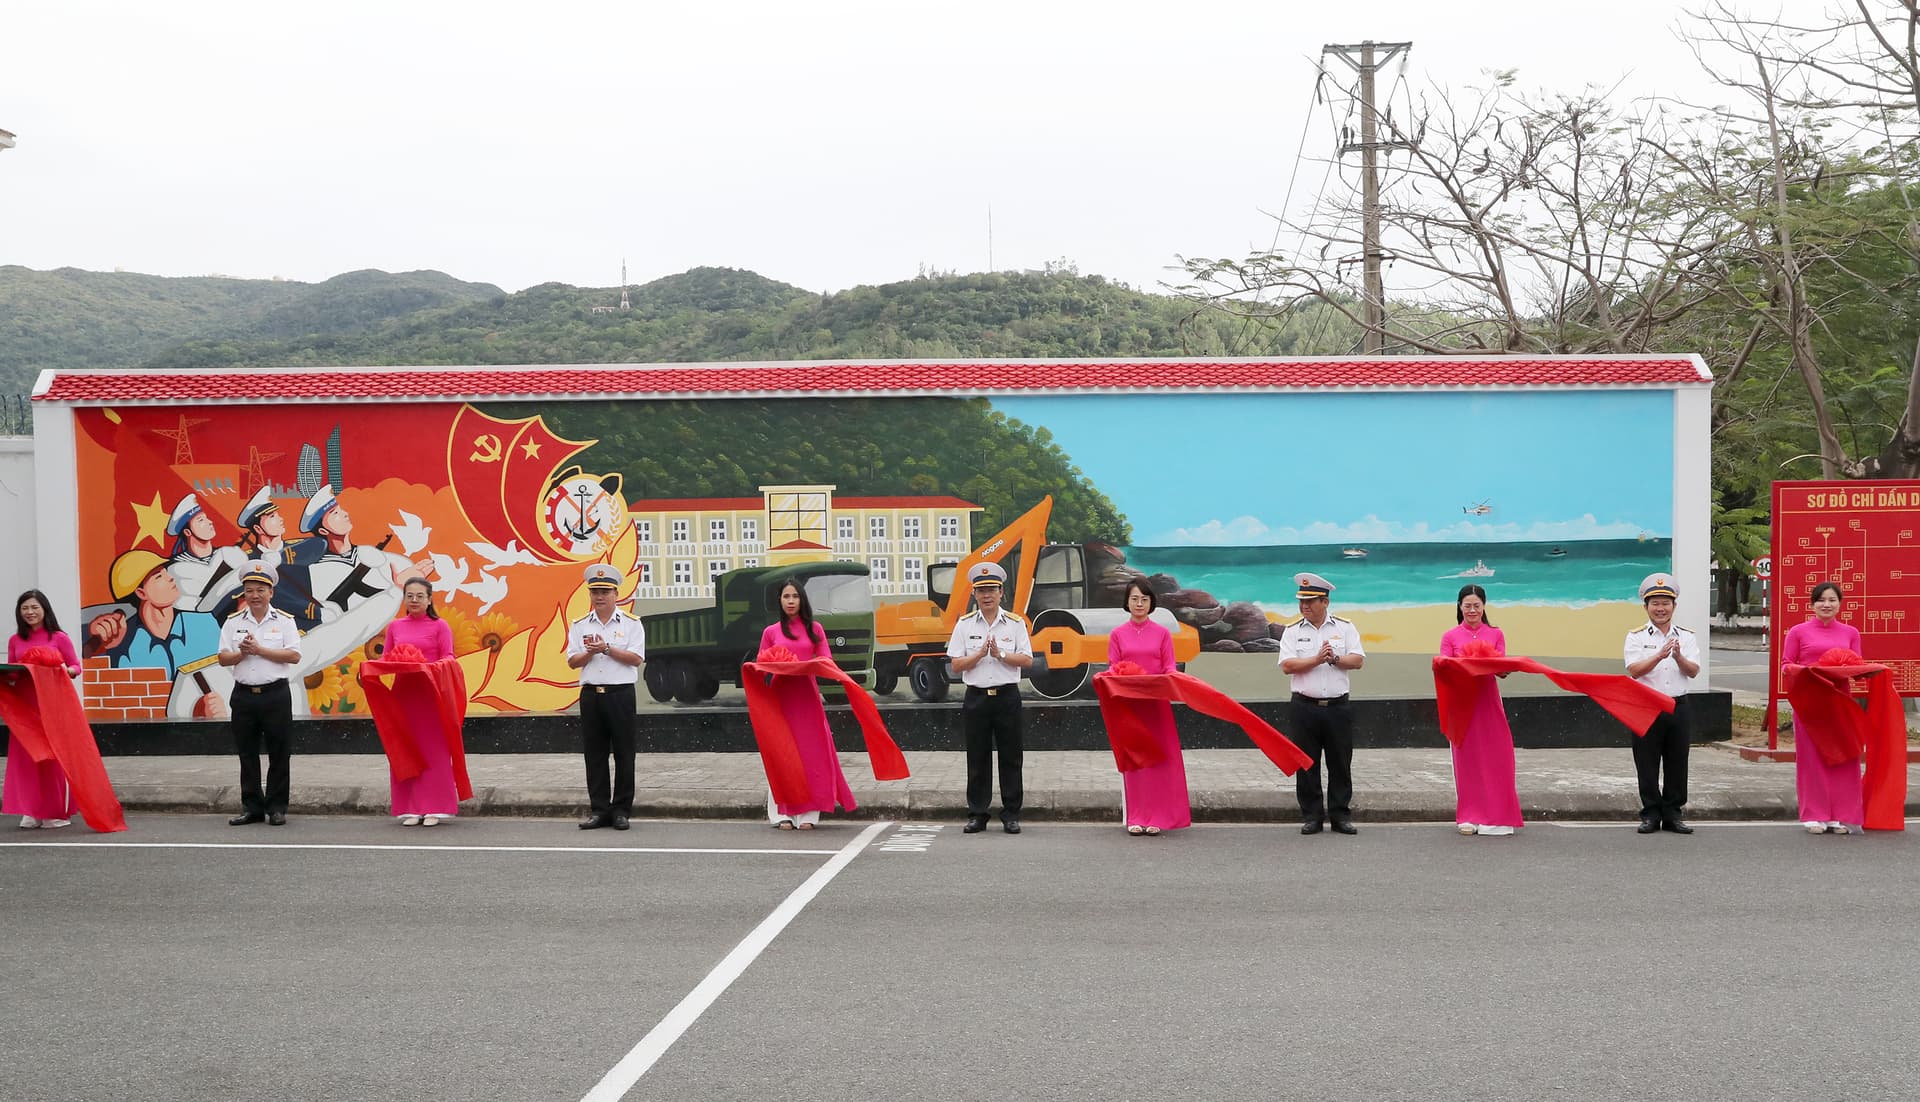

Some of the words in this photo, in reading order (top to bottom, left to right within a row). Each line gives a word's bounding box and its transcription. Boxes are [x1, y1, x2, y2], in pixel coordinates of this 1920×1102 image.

[1807, 492, 1826, 508] SƠ
[1829, 488, 1848, 508] ĐỒ
[1852, 487, 1875, 507] CHỈ
